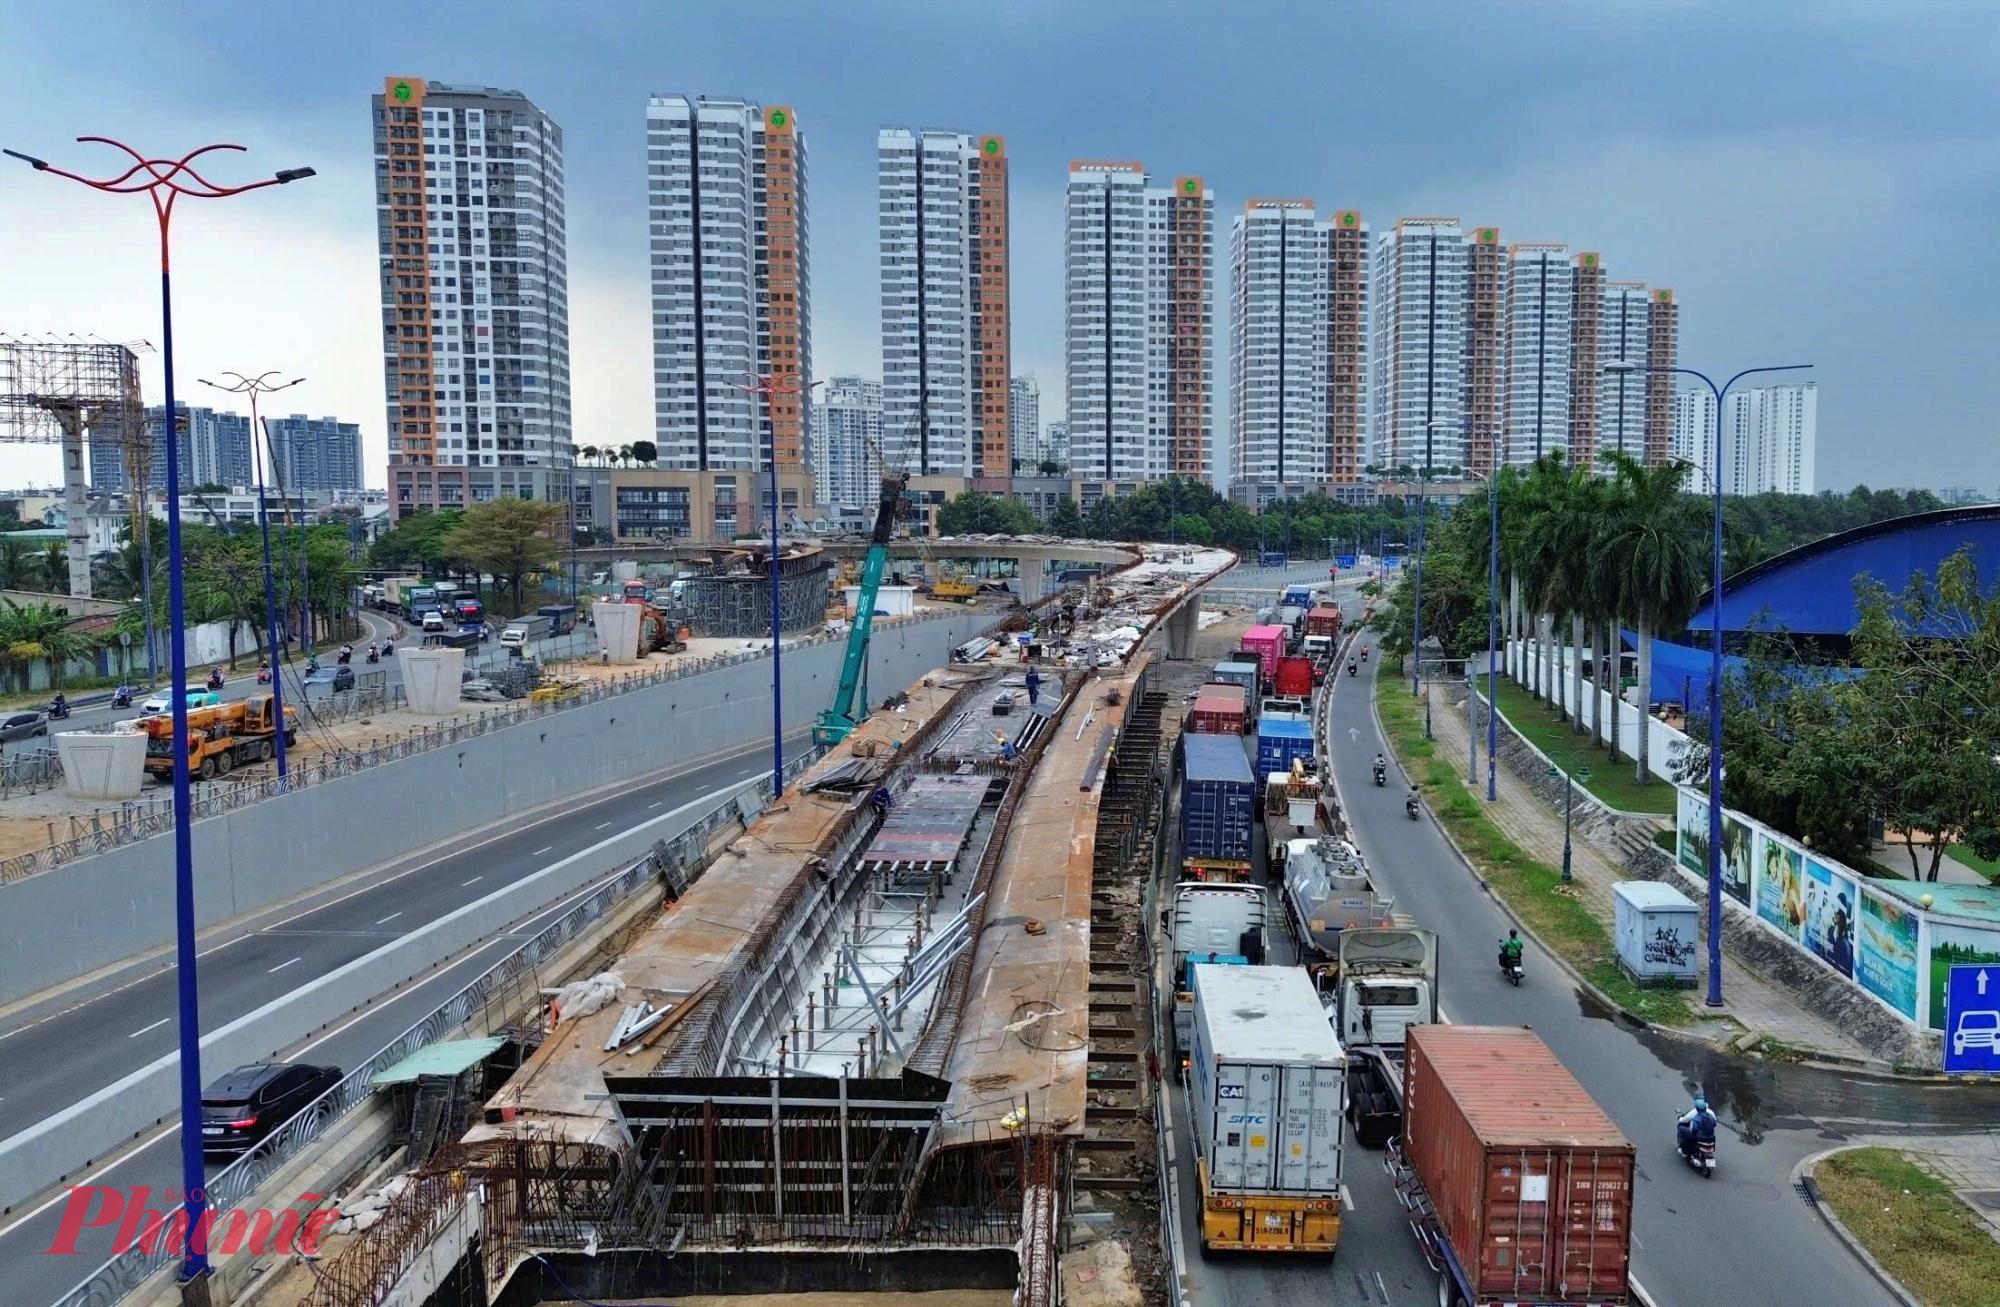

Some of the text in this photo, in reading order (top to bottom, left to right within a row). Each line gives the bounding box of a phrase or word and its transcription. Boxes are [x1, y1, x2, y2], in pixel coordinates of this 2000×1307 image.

[1655, 927, 1678, 943] 100%
[1220, 1087, 1243, 1097] CAI
[1227, 1115, 1266, 1124] SITC
[1576, 1181, 1590, 1189] SIKU
